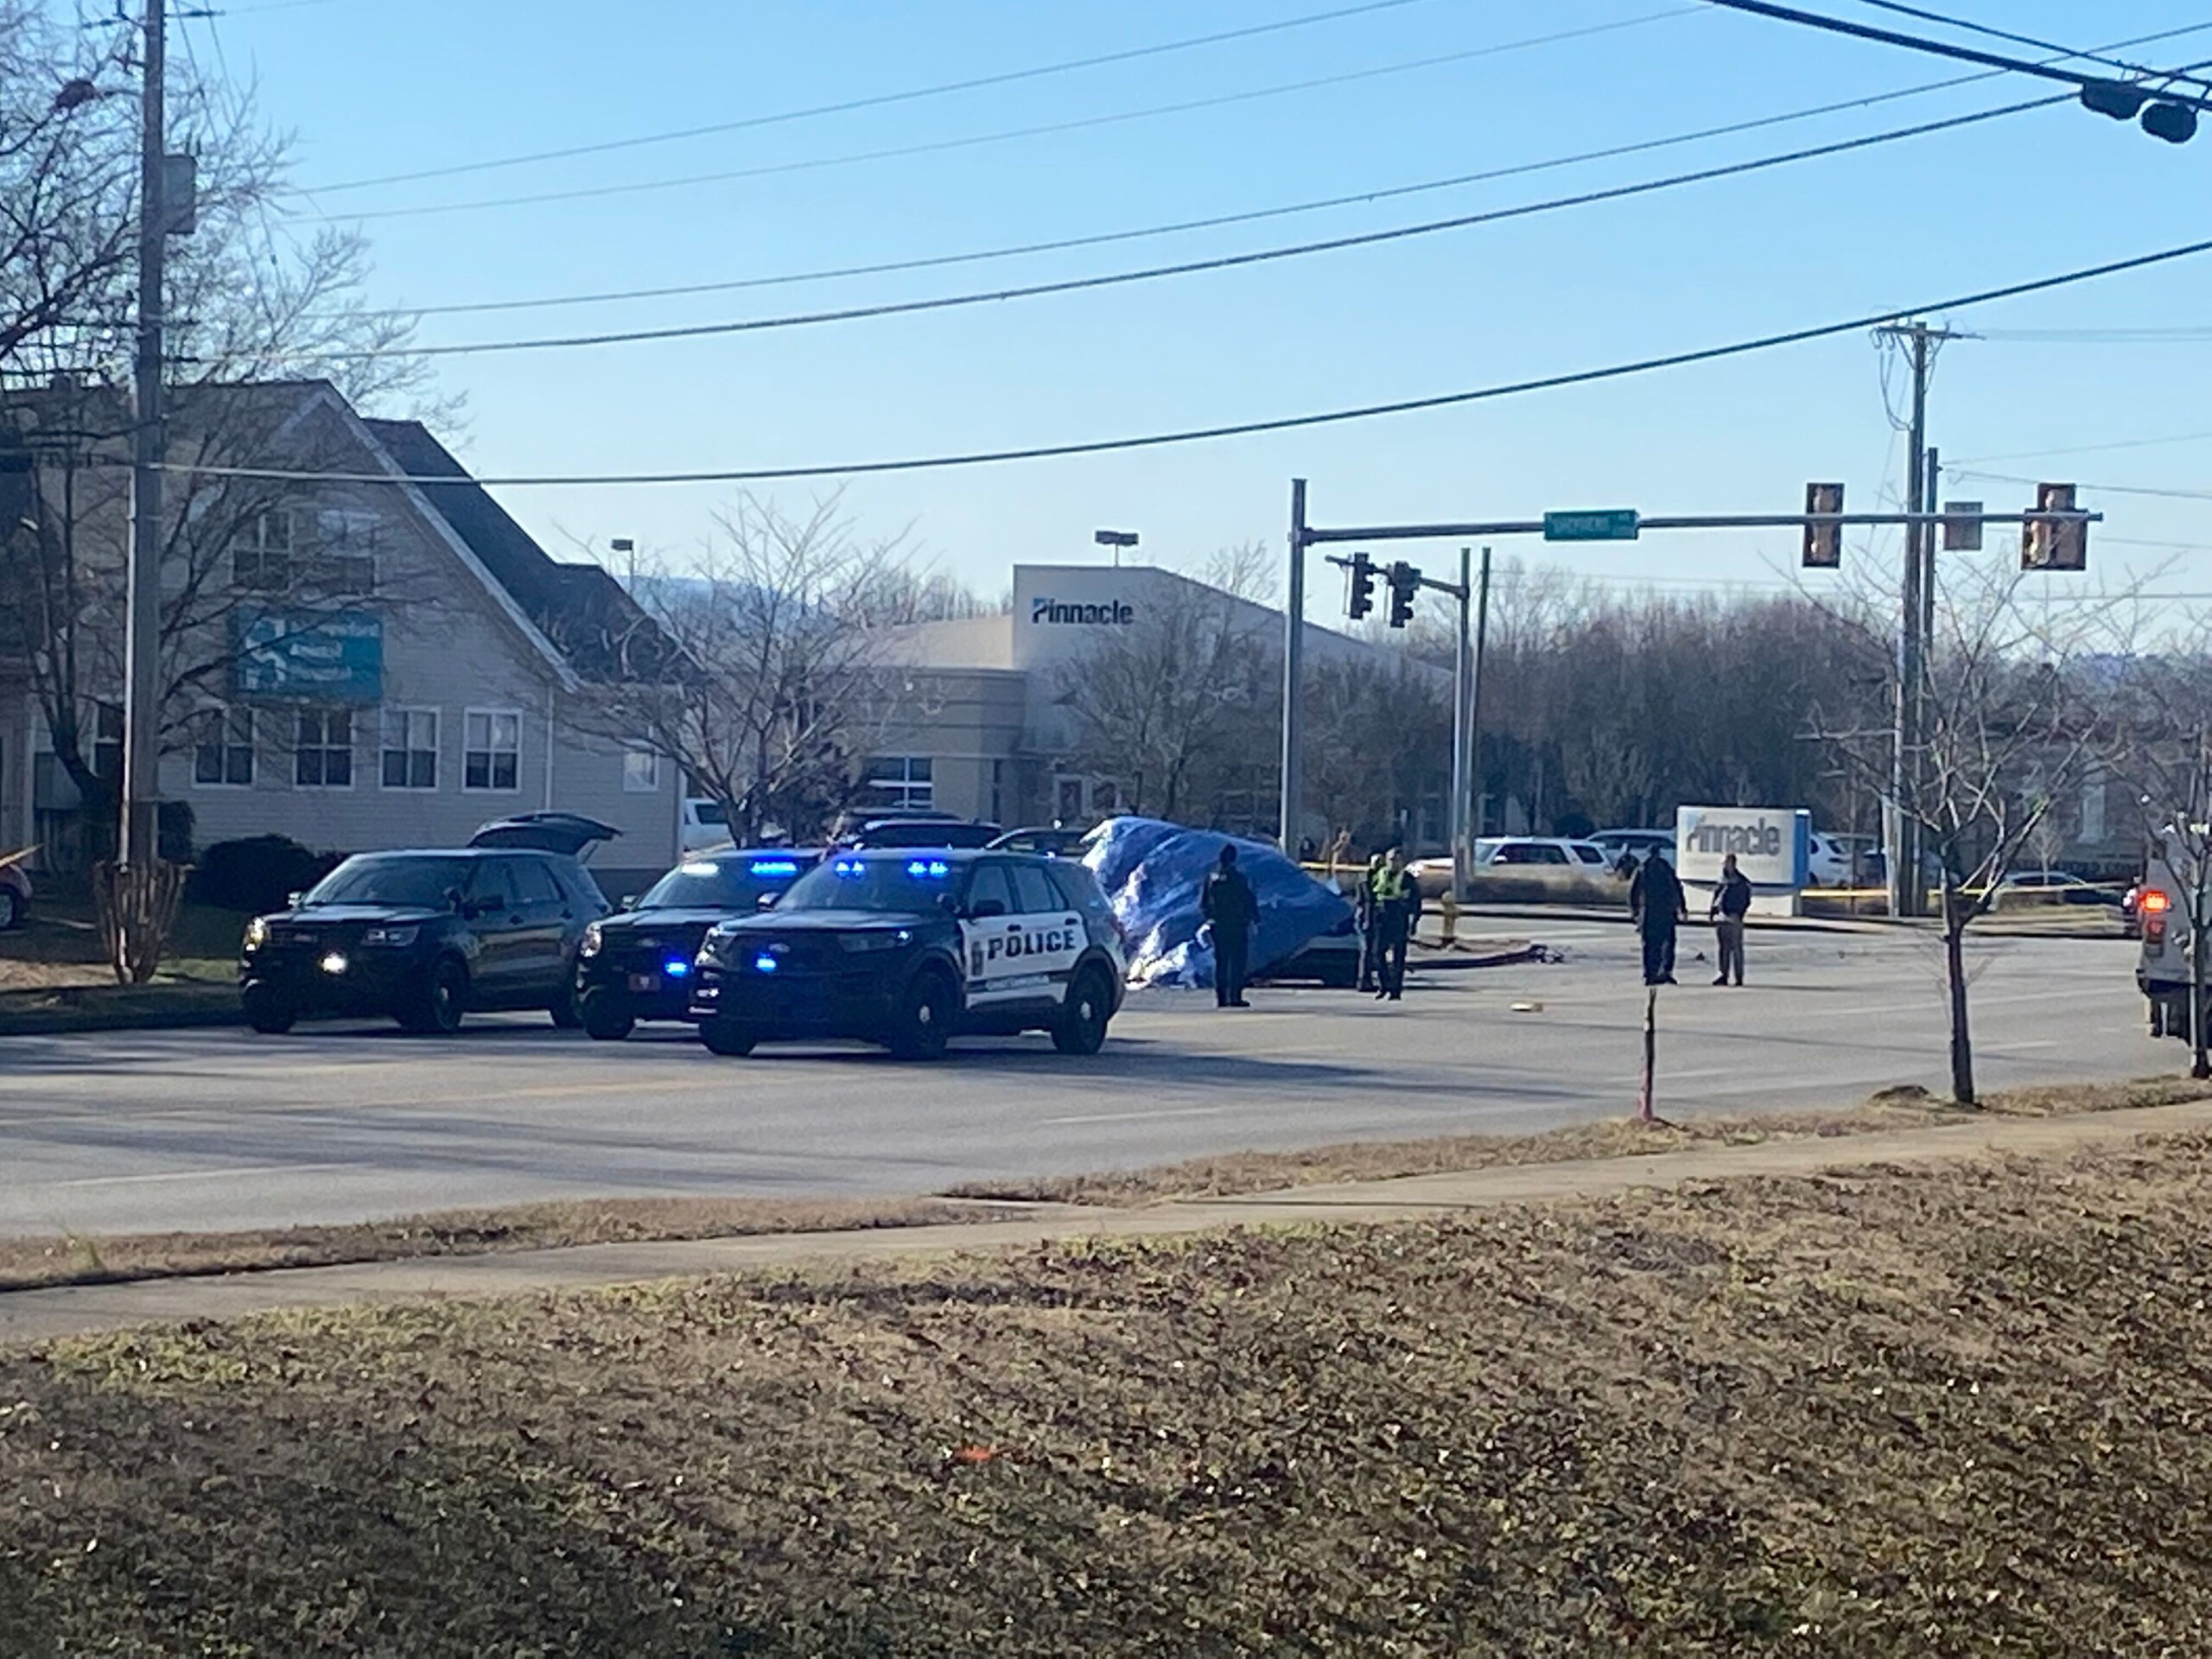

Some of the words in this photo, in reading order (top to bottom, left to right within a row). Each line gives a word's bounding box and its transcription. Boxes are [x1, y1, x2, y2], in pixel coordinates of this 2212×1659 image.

[1033, 598, 1135, 625] Pinnacle
[1686, 814, 1780, 855] Pinnacle
[987, 929, 1077, 960] POLICE
